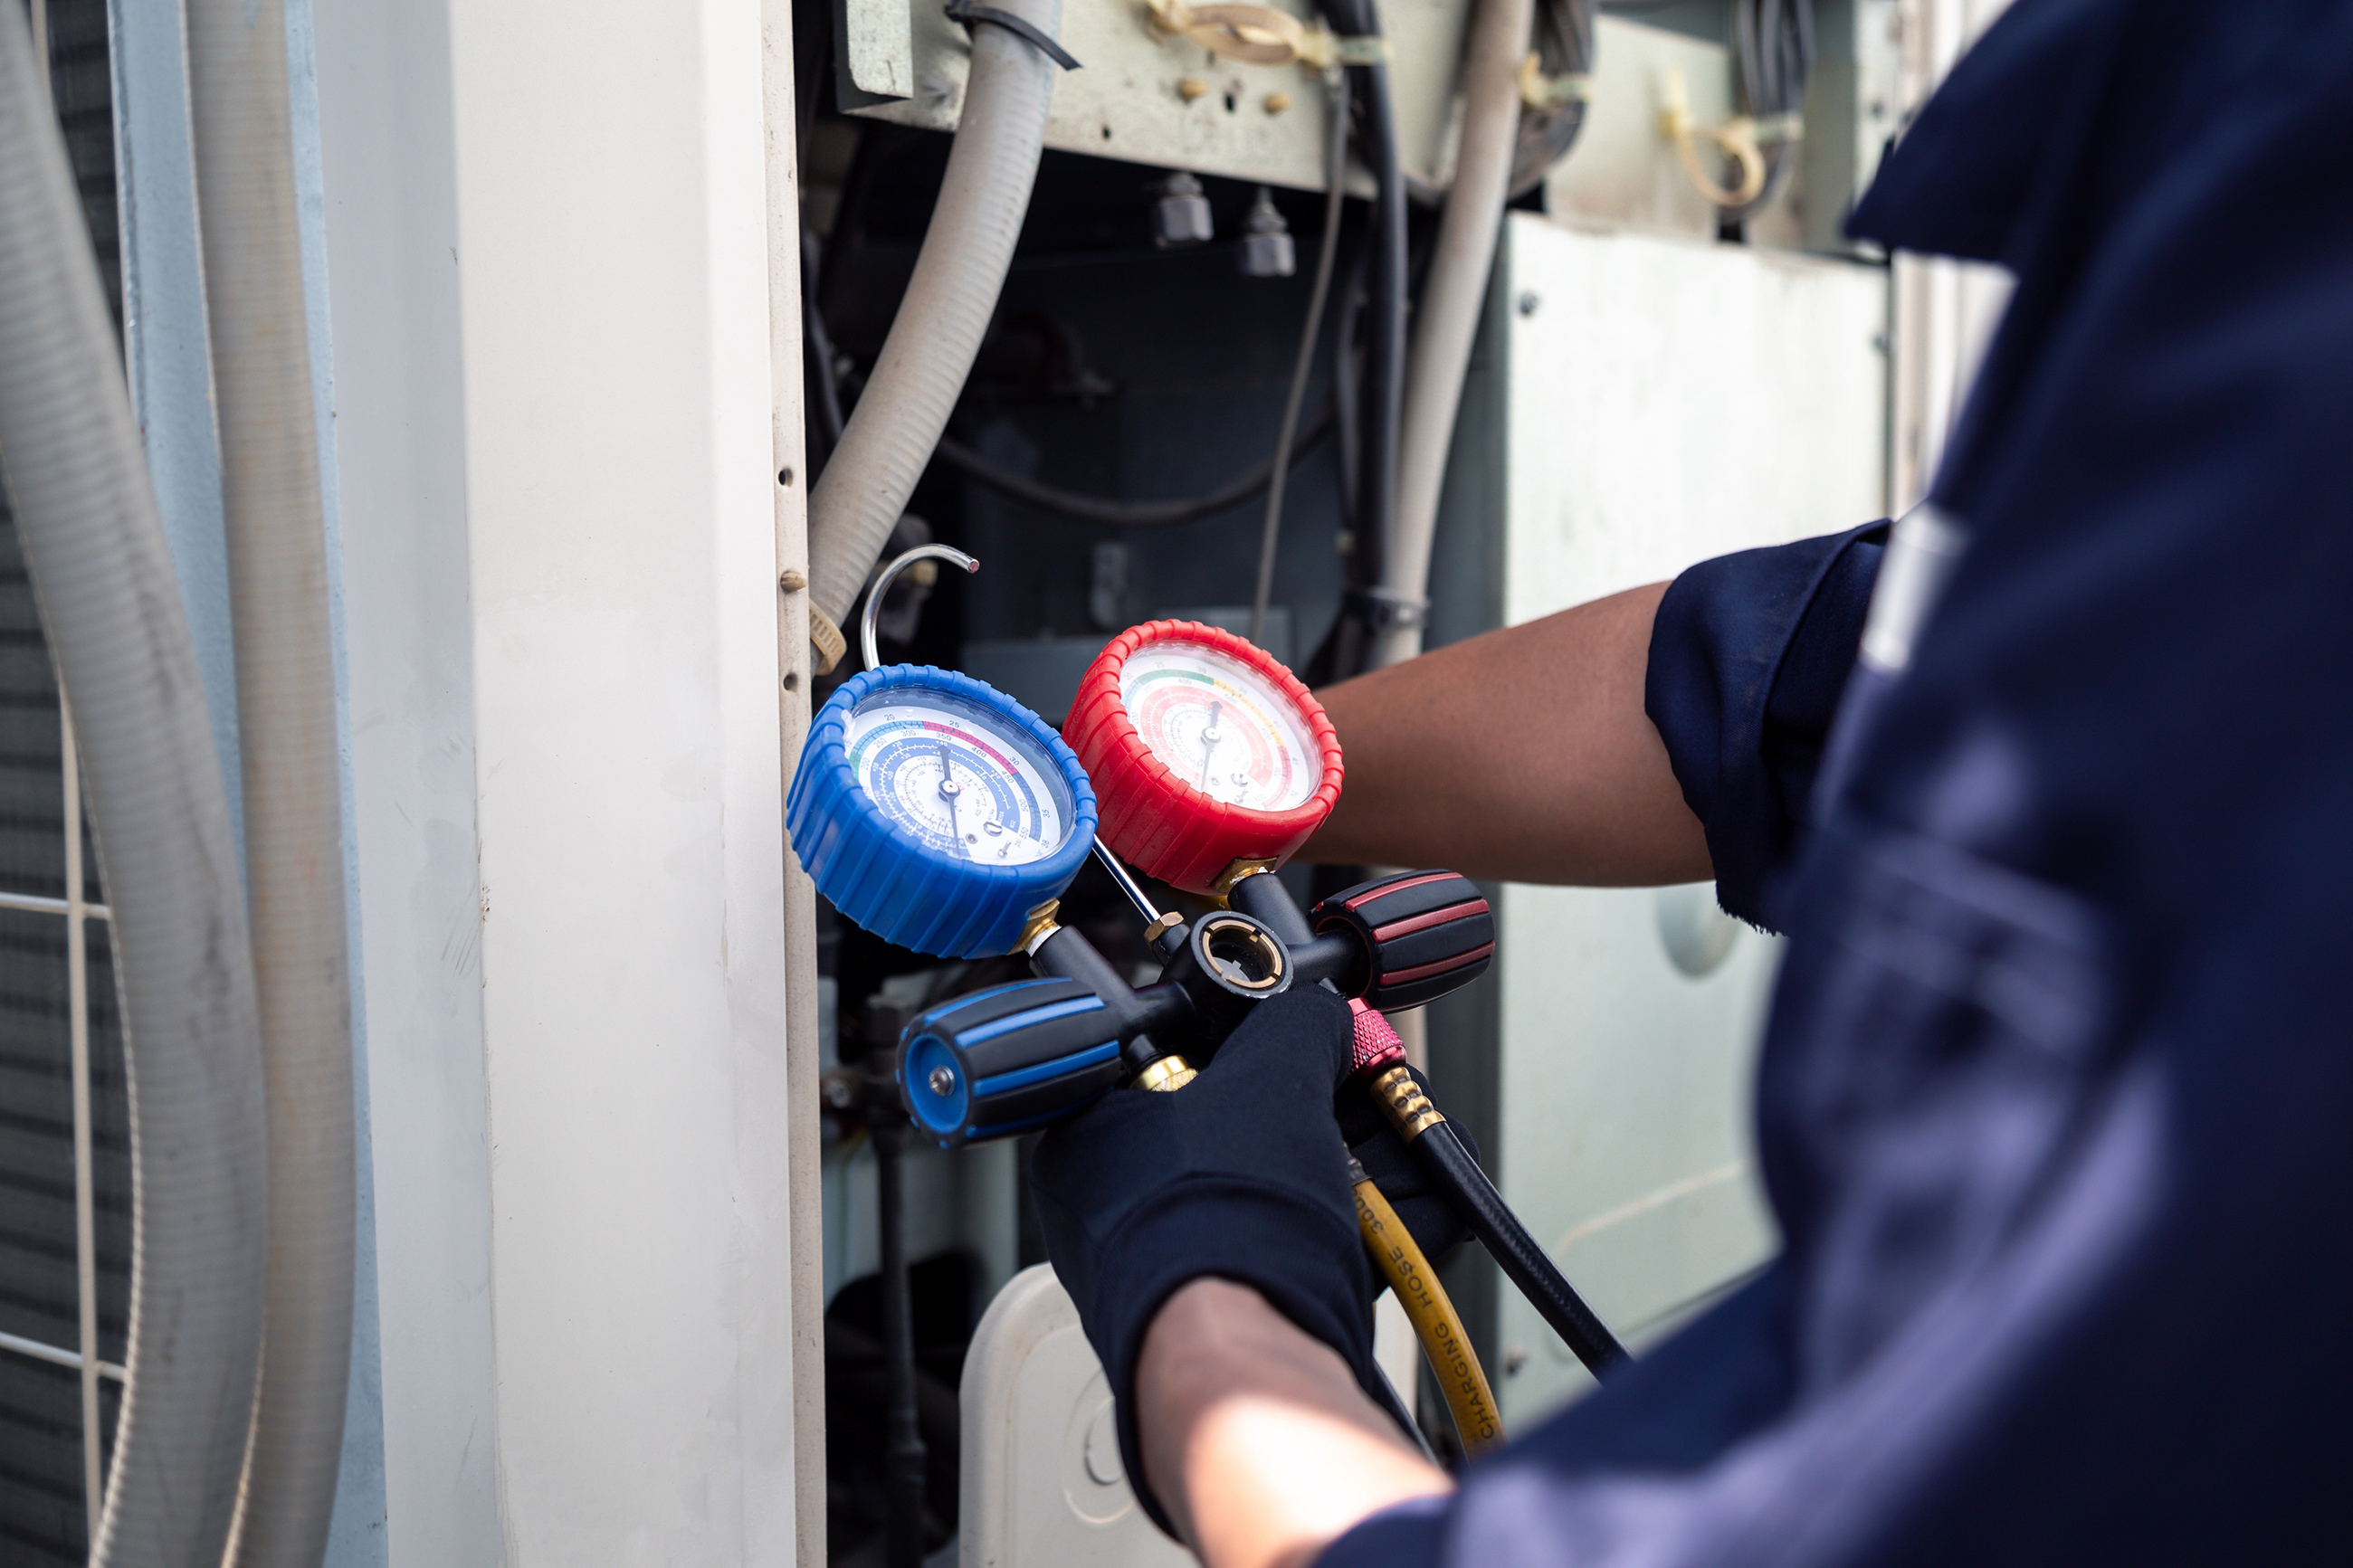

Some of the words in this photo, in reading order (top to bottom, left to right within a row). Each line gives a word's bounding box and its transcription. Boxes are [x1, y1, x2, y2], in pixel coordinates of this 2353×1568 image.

[949, 720, 960, 728] 25
[936, 732, 952, 741] 350
[873, 737, 887, 748] 250
[971, 747, 987, 758] 400
[860, 757, 870, 770] 200
[1009, 756, 1019, 766] 30
[1001, 770, 1014, 784] 450
[1019, 799, 1029, 813] 500
[1042, 808, 1050, 818] 35
[1019, 827, 1029, 840] 550
[1041, 839, 1050, 849] 38
[1387, 1245, 1433, 1309] HOSE
[1434, 1322, 1494, 1440] CHARGING
